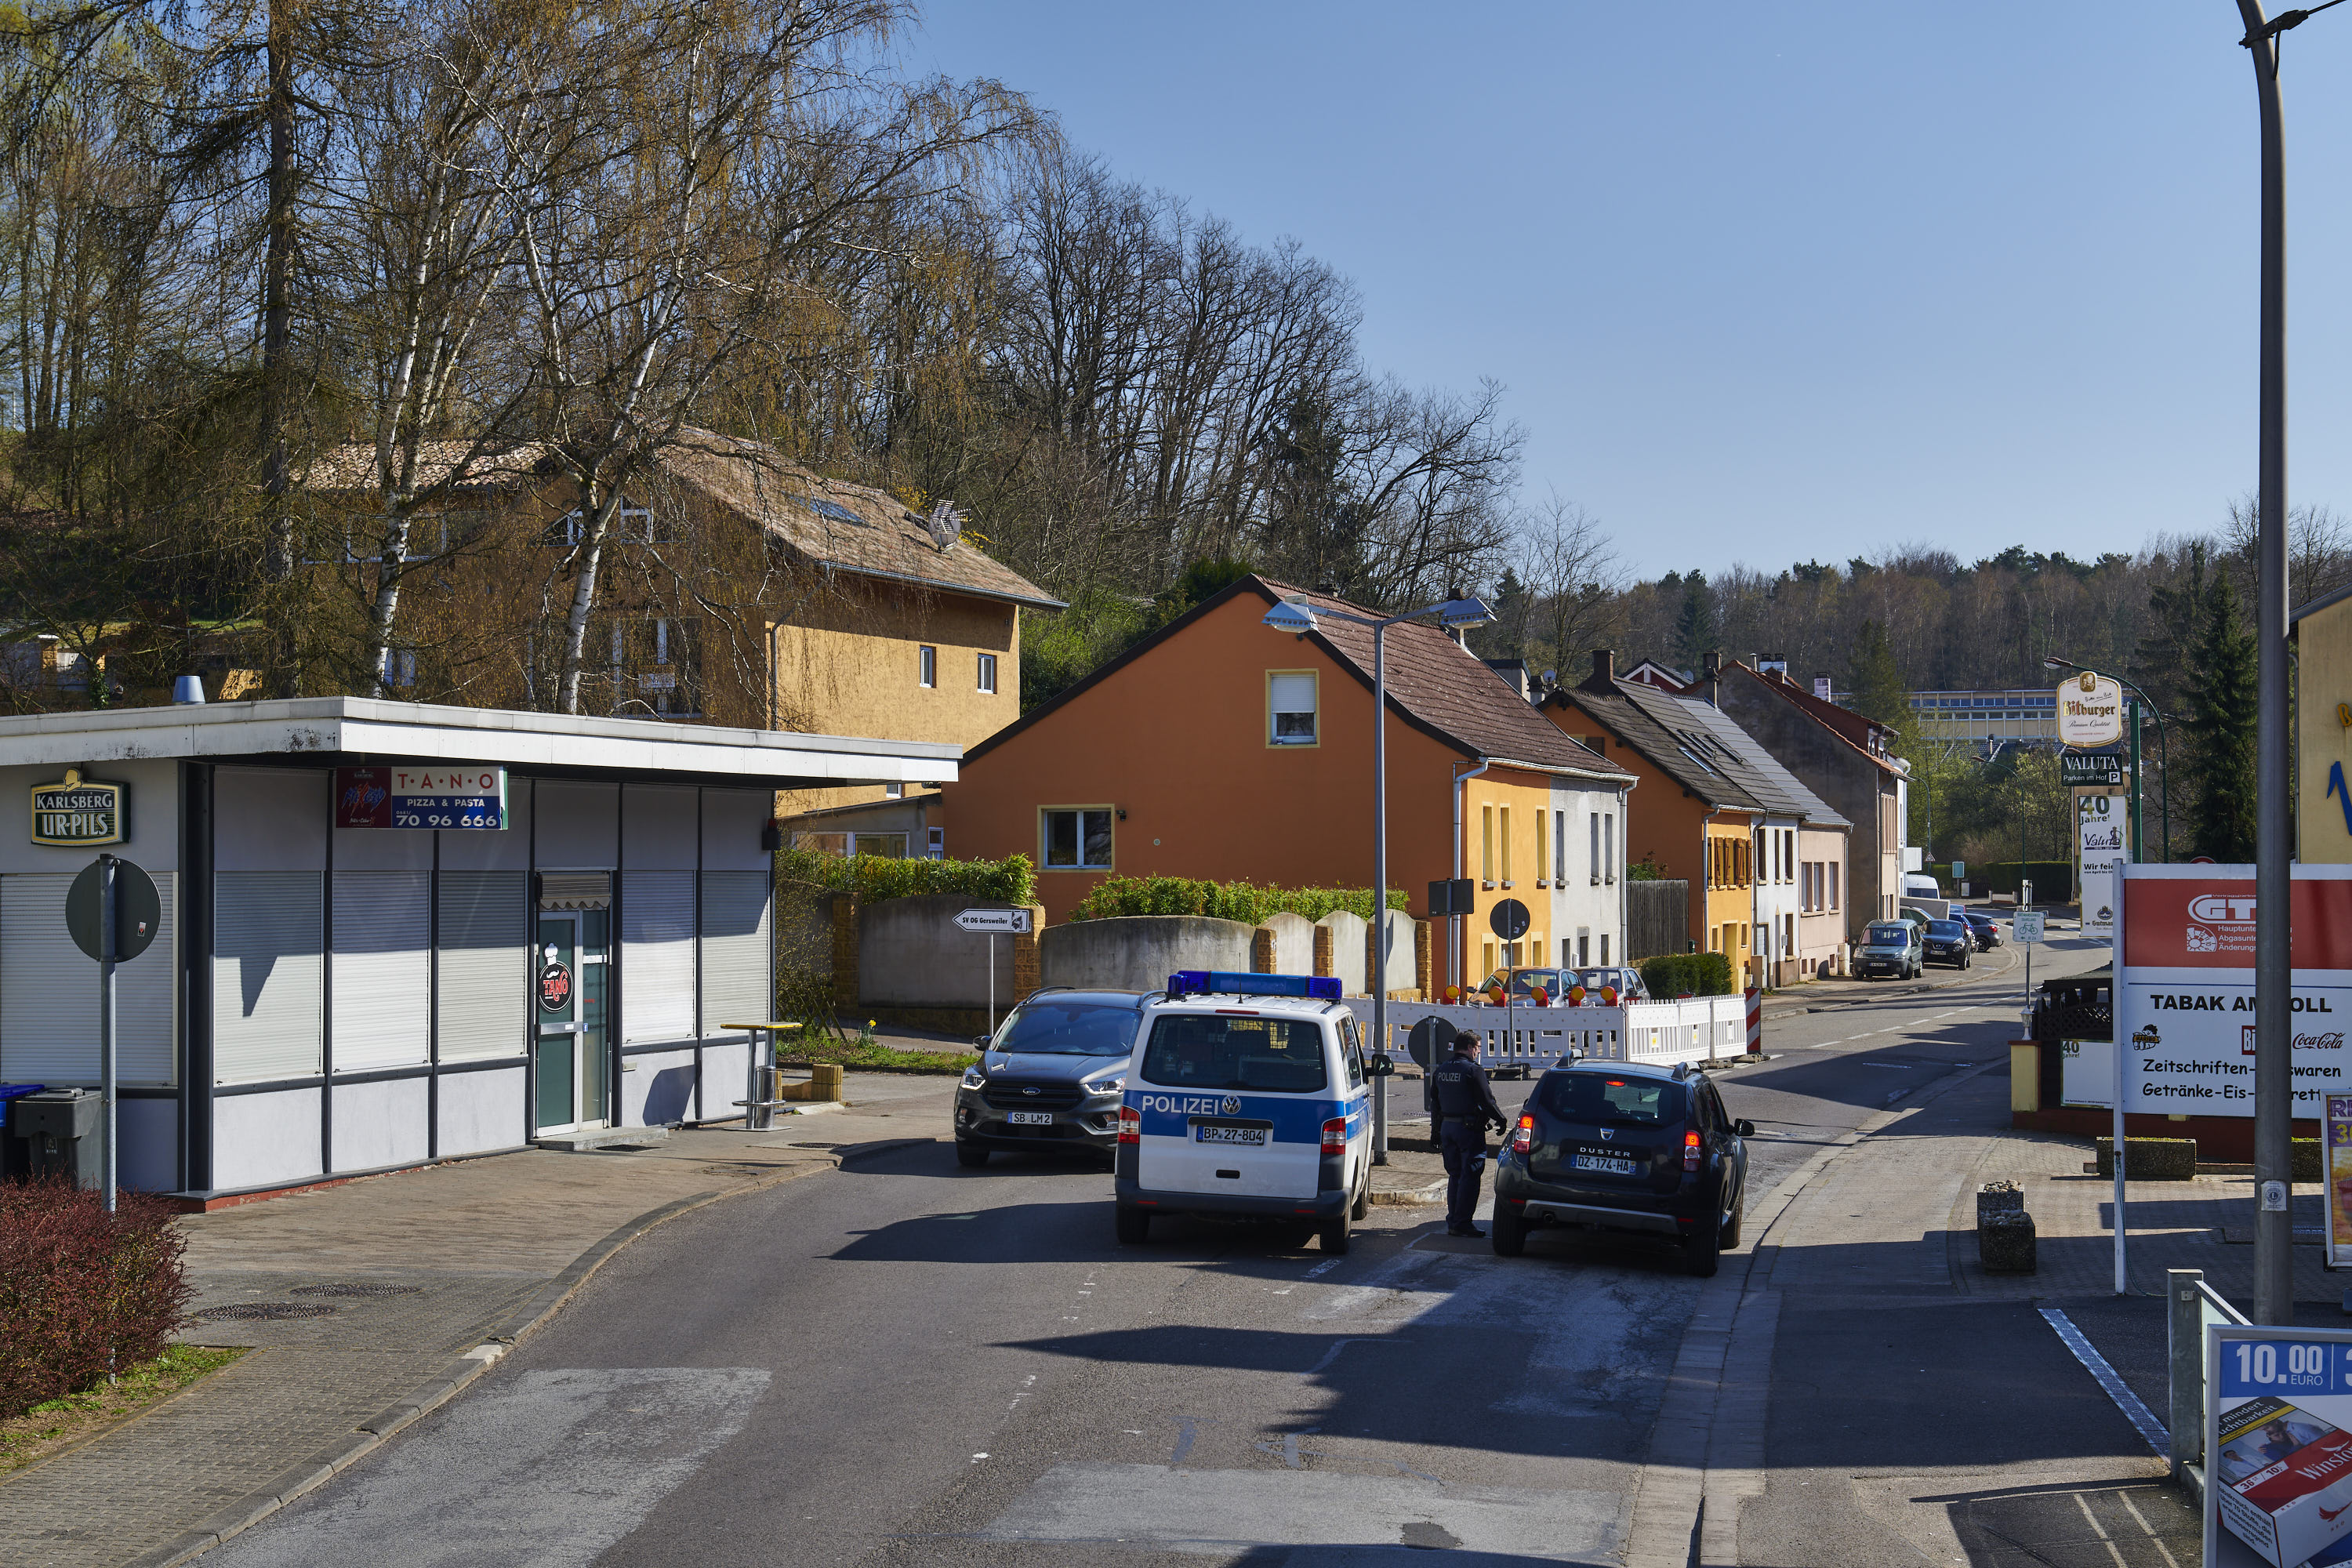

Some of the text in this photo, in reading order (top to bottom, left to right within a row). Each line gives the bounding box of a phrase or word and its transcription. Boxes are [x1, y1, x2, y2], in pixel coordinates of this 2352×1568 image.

[2063, 700, 2115, 717] Bitburger
[2064, 756, 2118, 770] VALUTA
[36, 793, 112, 809] KARLSBERG
[407, 798, 485, 807] PIZZA & PASTA
[2079, 796, 2110, 815] 40
[42, 813, 108, 836] UR-PILS
[396, 815, 497, 826] 70 96 666
[2084, 831, 2122, 846] Valuta
[2194, 898, 2256, 919] GT
[2218, 935, 2256, 943] Abgasunte
[2218, 942, 2256, 952] Änderungs
[543, 971, 568, 1002] TANO
[2150, 995, 2226, 1011] TABAK
[2063, 1040, 2080, 1053] 40
[1438, 1072, 1461, 1082] POLIZEI
[1142, 1095, 1218, 1116] POLIZEI
[1014, 1113, 1025, 1123] SB
[1203, 1127, 1262, 1142] BP 27-804
[1580, 1146, 1631, 1157] DUSTER
[1577, 1156, 1628, 1171] DZ-174-HA
[2291, 1374, 2323, 1386] EURO
[2222, 1400, 2264, 1423] mindert
[2219, 1403, 2278, 1436] uchtbarkeit
[2295, 1446, 2352, 1480] Winsto
[2240, 1479, 2255, 1490] 36
[2250, 1509, 2272, 1528] enthält
